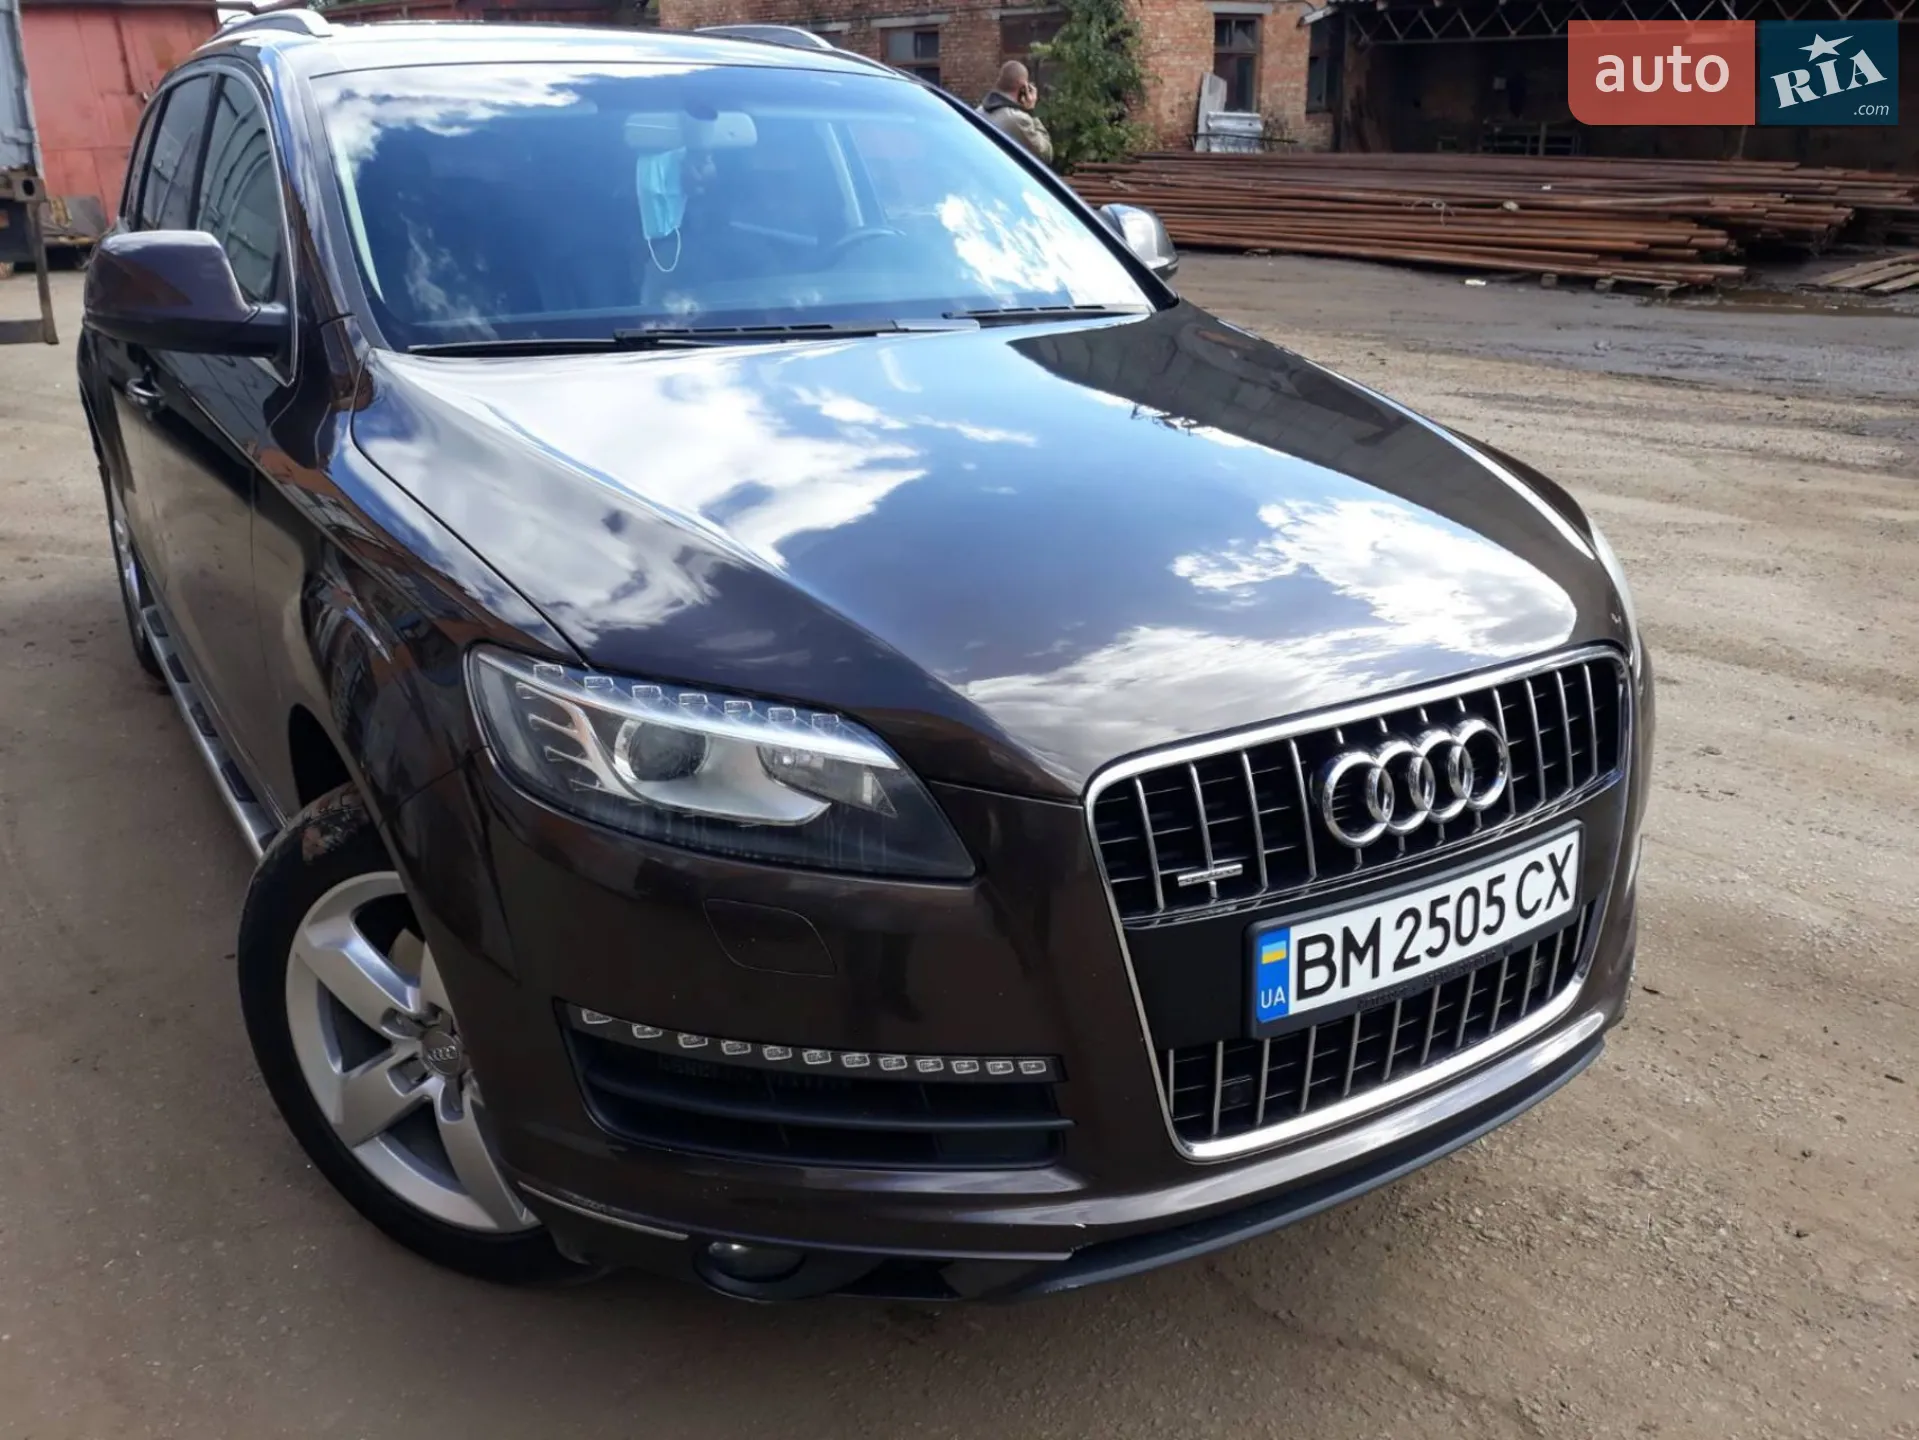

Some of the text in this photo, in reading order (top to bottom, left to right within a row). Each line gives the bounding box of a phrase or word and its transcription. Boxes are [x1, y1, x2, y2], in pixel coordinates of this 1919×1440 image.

[1296, 916, 1382, 1002] BM
[1392, 873, 1506, 973] 2505
[1515, 843, 1574, 920] CX
[1260, 986, 1286, 1009] UA
